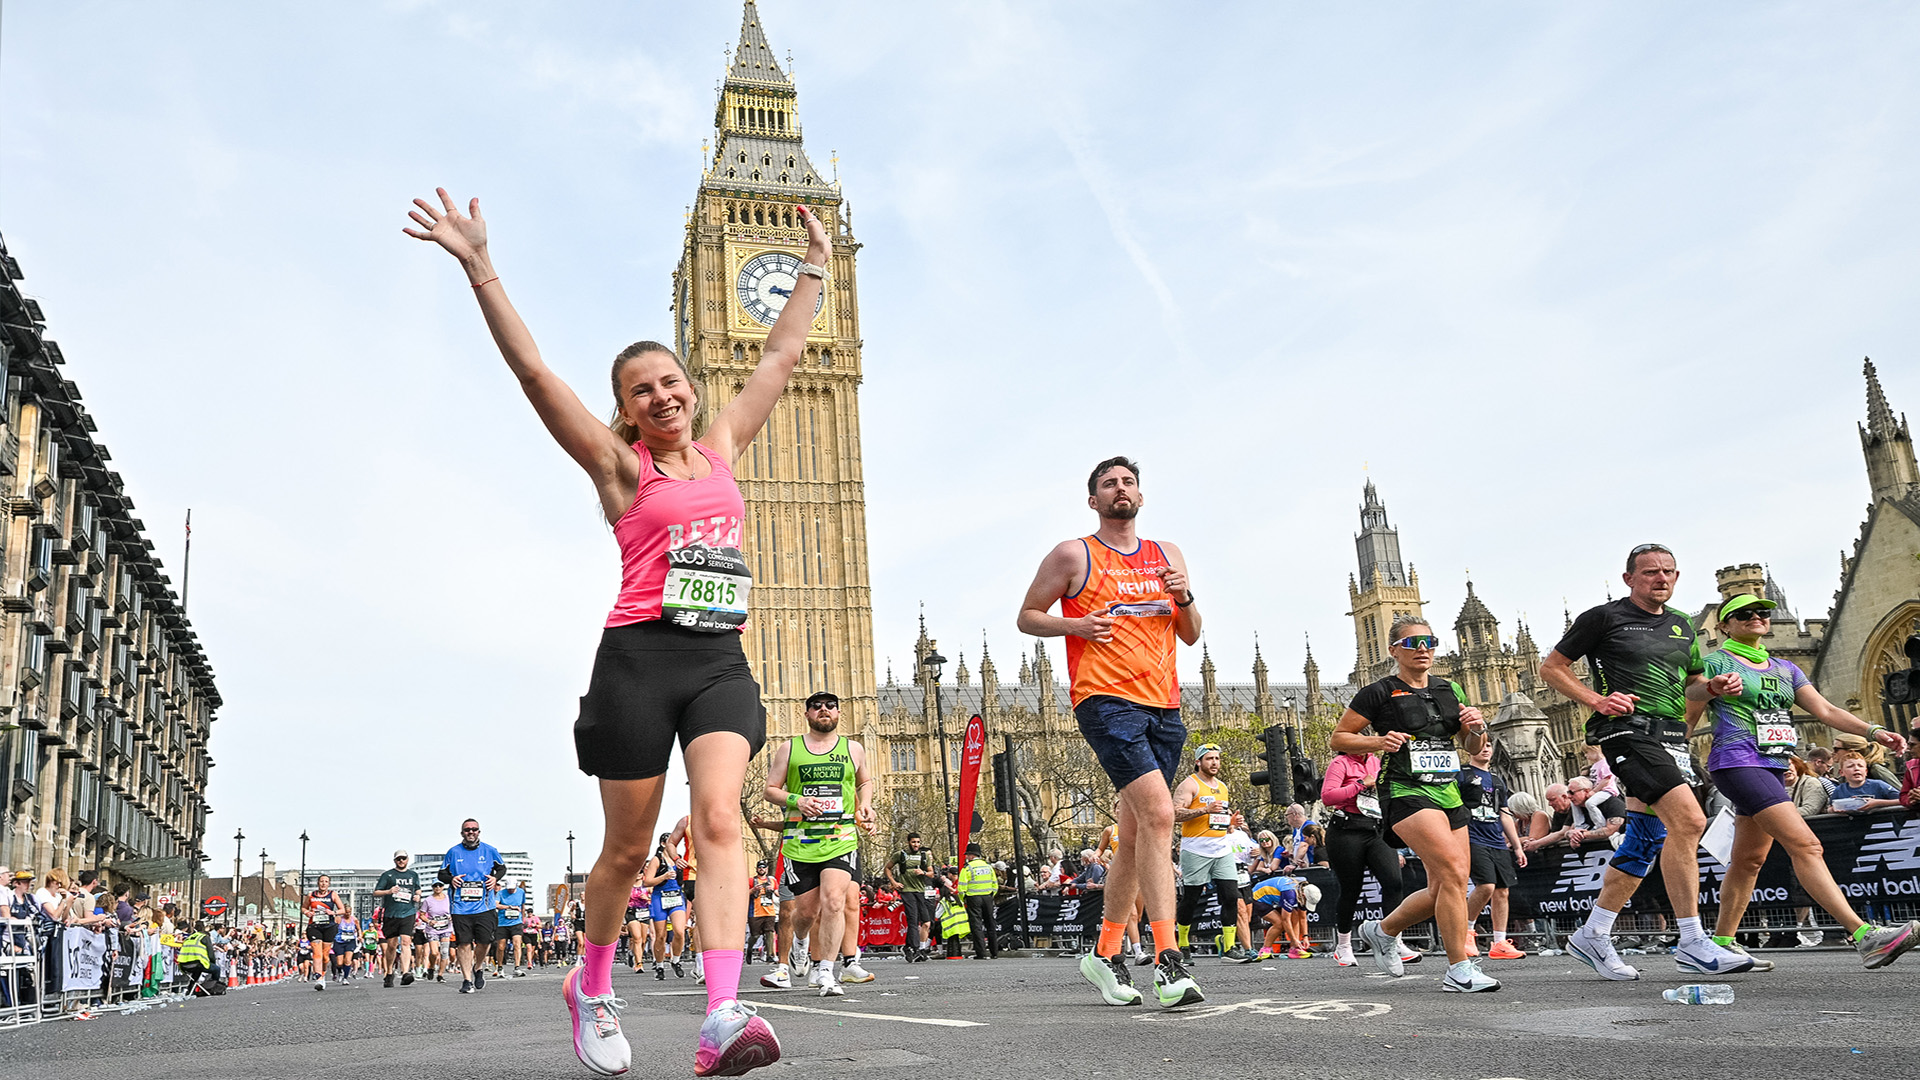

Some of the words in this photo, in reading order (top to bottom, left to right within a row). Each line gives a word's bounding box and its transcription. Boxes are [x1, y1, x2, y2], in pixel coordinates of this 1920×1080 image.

[679, 577, 738, 605] 78815
[1116, 580, 1160, 595] KEVIN
[698, 620, 714, 628] new
[829, 753, 848, 763] SAM
[1419, 755, 1452, 768] 67026
[812, 770, 841, 779] NOLAN
[1838, 882, 1878, 897] new
[1539, 900, 1567, 912] new
[1063, 924, 1084, 932] balance
[1197, 922, 1210, 930] new
